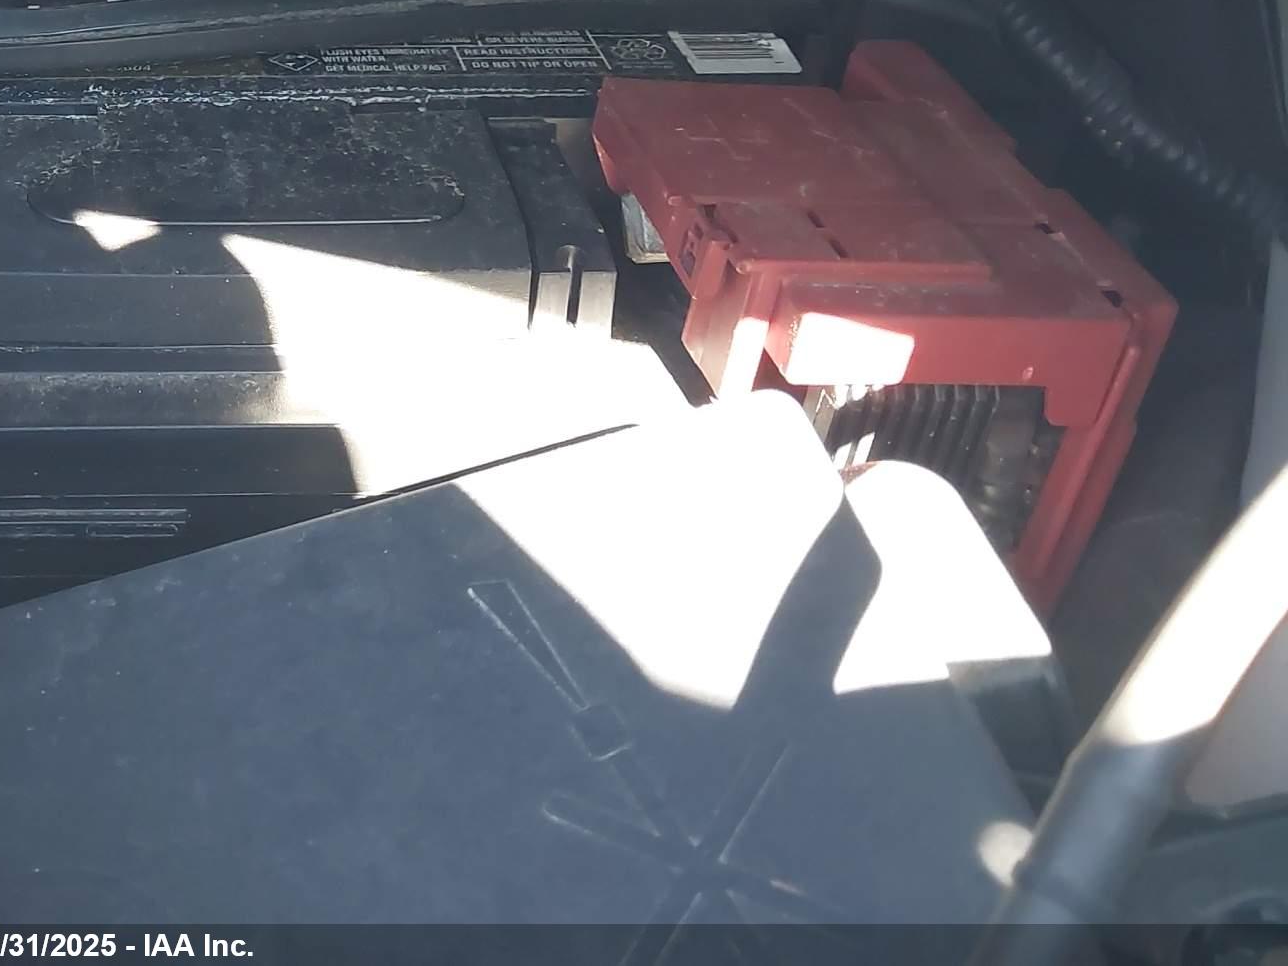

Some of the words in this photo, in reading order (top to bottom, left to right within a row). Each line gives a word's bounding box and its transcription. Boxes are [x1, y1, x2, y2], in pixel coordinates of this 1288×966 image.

[499, 47, 591, 55] INSTRUCTIONS
[325, 64, 345, 72] GET
[346, 64, 393, 72] MEDICAL
[393, 63, 420, 71] HELP
[563, 60, 598, 68] OPEN
